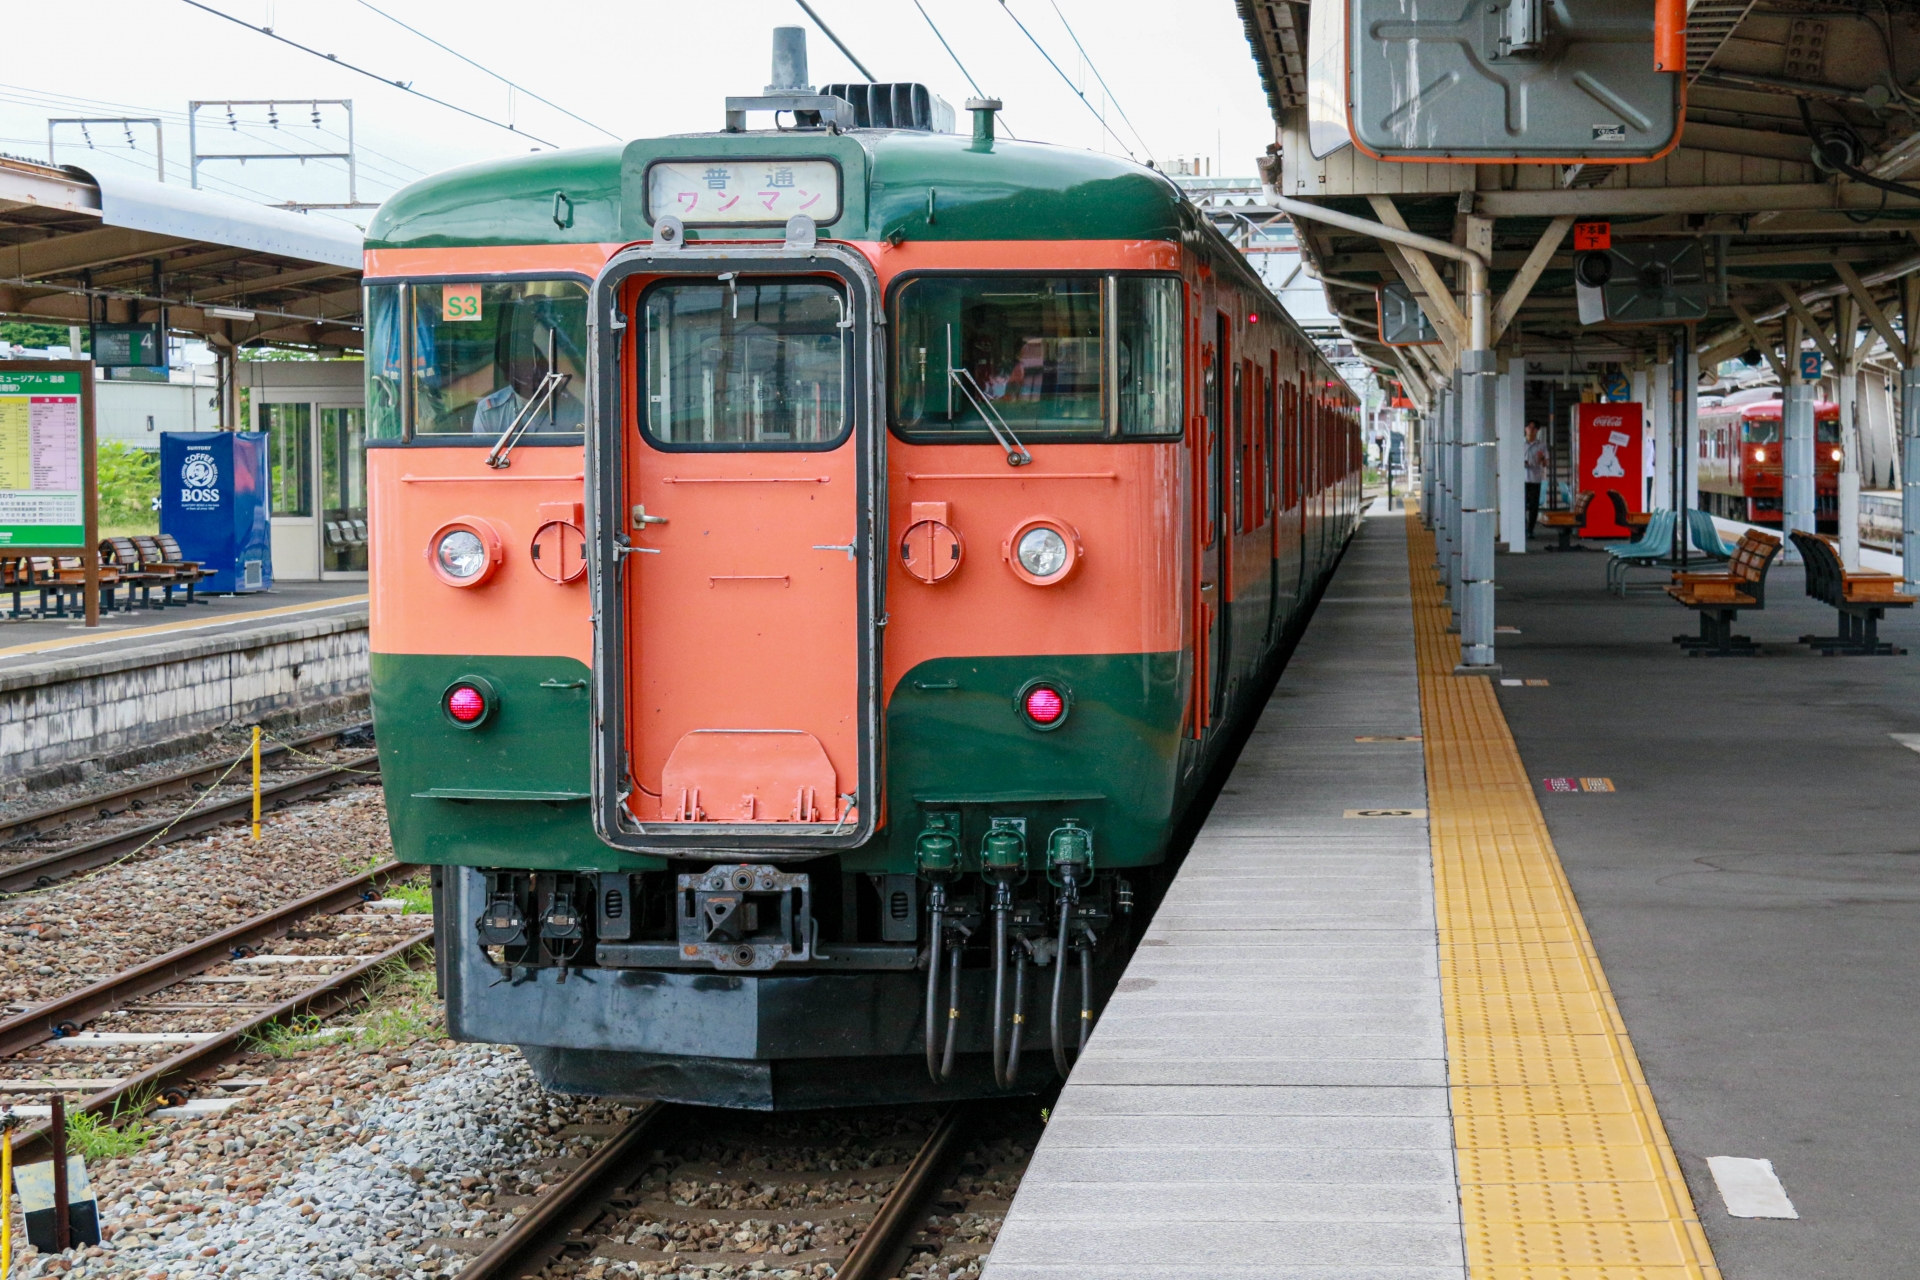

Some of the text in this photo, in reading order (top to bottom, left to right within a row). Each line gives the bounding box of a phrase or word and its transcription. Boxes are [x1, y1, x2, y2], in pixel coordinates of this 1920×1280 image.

[702, 166, 796, 190] 普通
[677, 189, 822, 213] ワンマン
[1585, 236, 1599, 247] 下
[447, 295, 479, 317] S3
[141, 333, 153, 349] 4
[1805, 357, 1818, 373] 2
[1612, 379, 1627, 396] 2
[184, 452, 215, 465] COFFEE
[181, 488, 220, 502] BOSS
